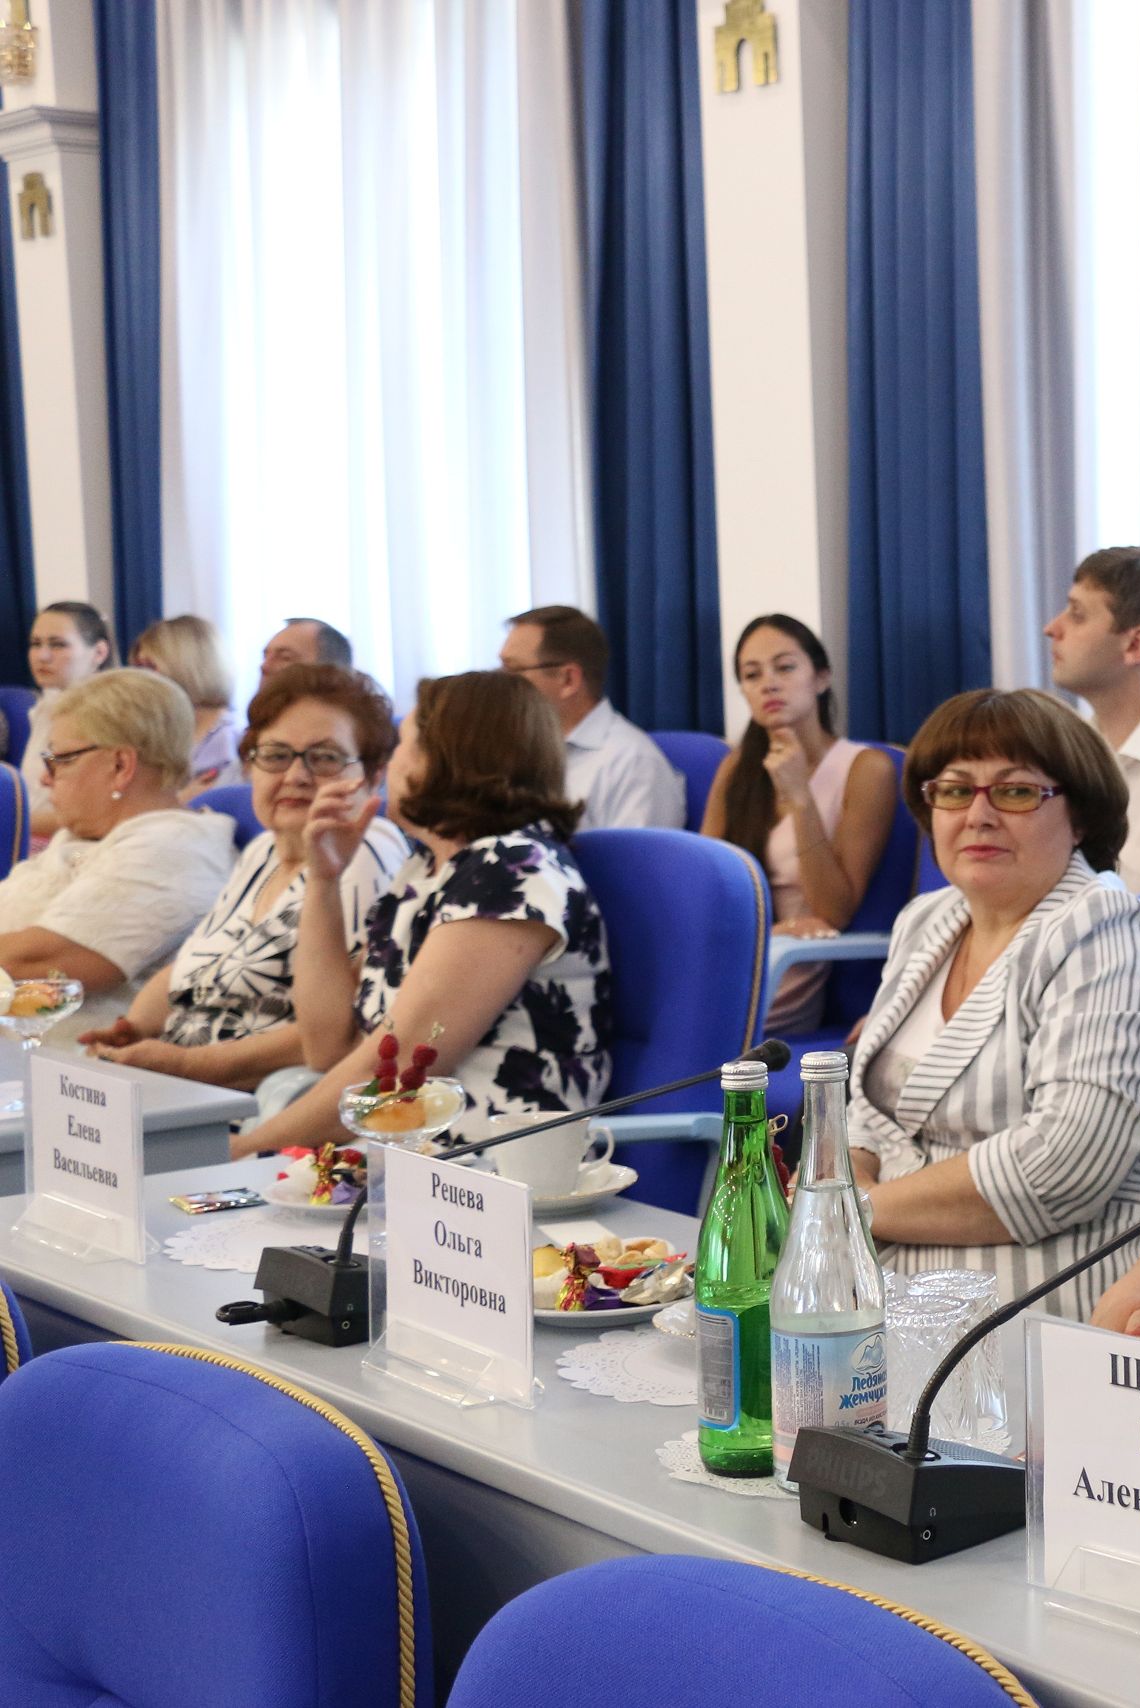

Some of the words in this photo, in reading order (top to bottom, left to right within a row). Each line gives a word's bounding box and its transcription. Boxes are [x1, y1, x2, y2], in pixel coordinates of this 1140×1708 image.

[60, 1074, 106, 1107] Костина
[67, 1114, 101, 1144] Елена
[53, 1147, 118, 1188] Васильевна
[431, 1172, 484, 1212] Рецева
[434, 1219, 482, 1258] Ольга
[413, 1258, 506, 1314] Викторовна
[804, 1448, 888, 1497] PHILIPS
